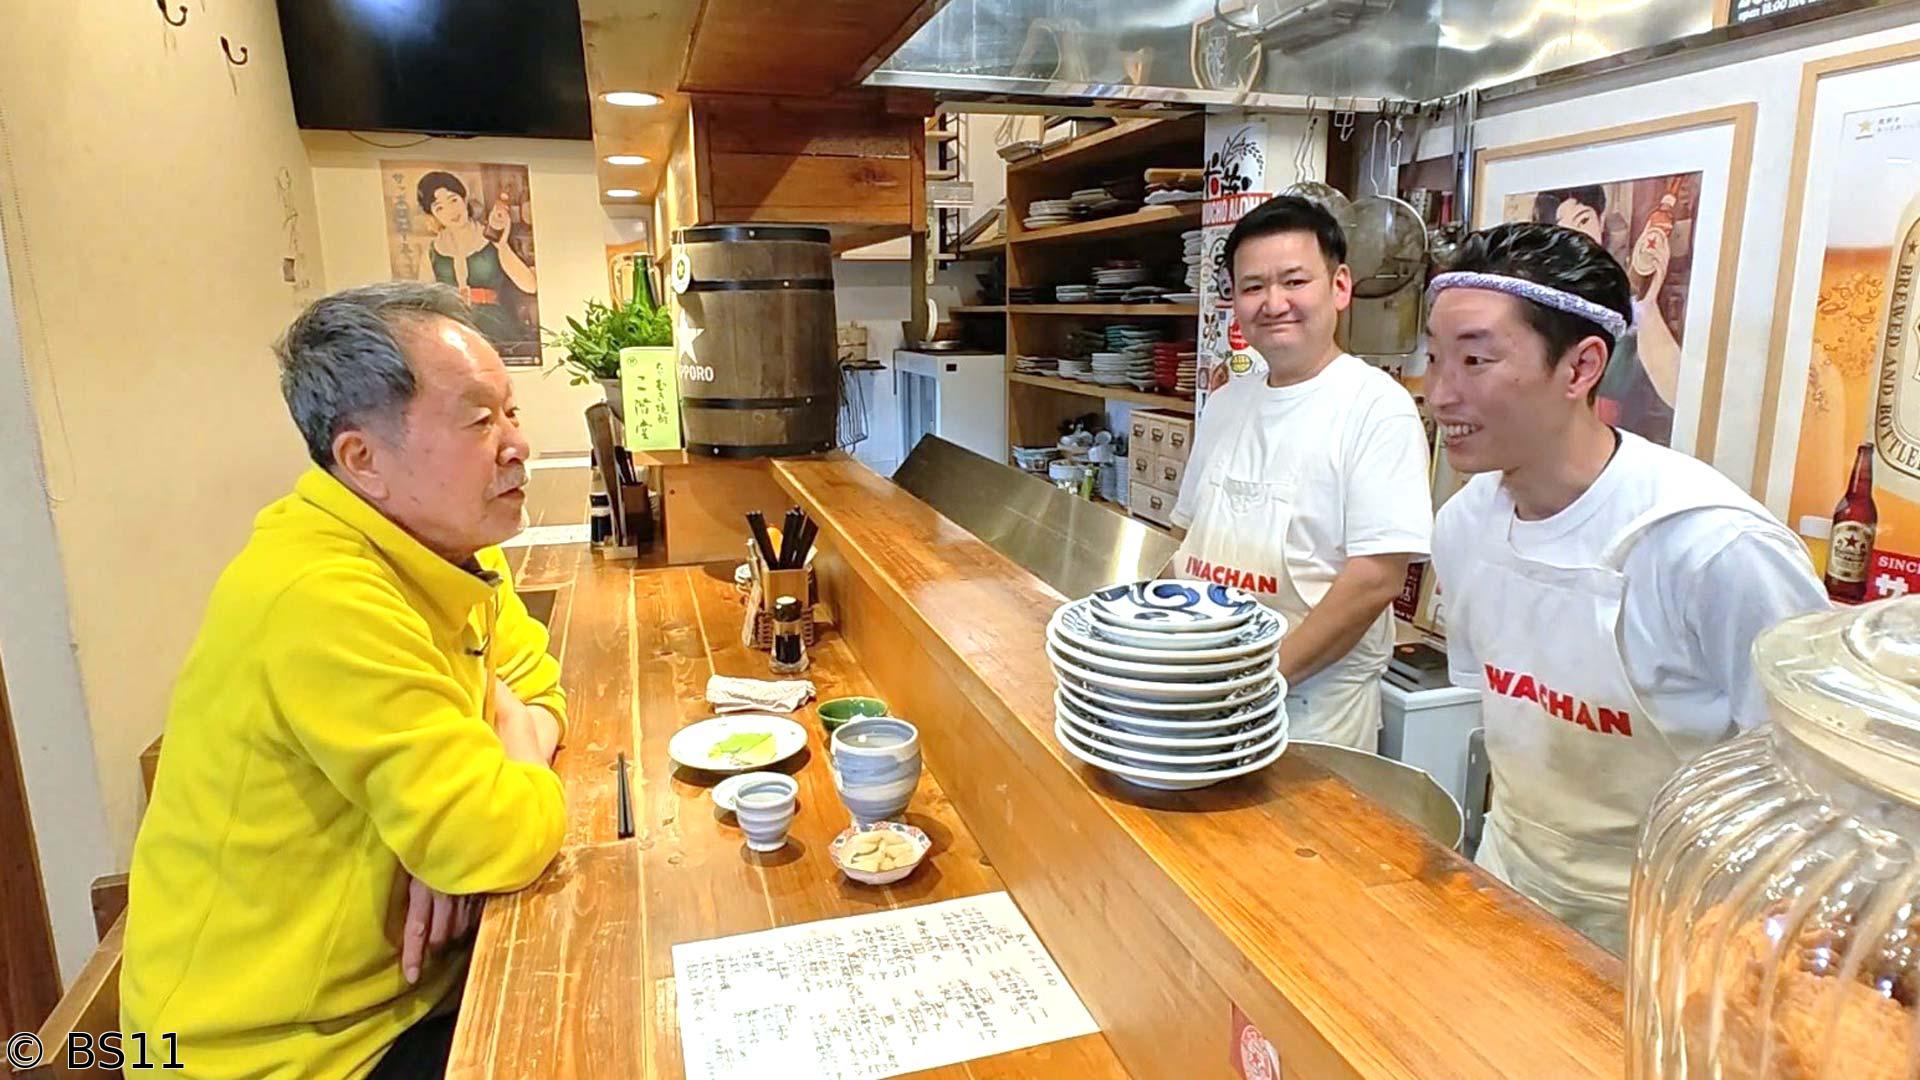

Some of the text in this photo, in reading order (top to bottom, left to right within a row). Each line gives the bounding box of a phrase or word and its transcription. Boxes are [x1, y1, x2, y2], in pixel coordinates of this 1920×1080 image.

[1878, 264, 1920, 471] BREWED AND BOTTLE
[1878, 555, 1920, 576] SINC
[1484, 663, 1633, 737] WACHAN
